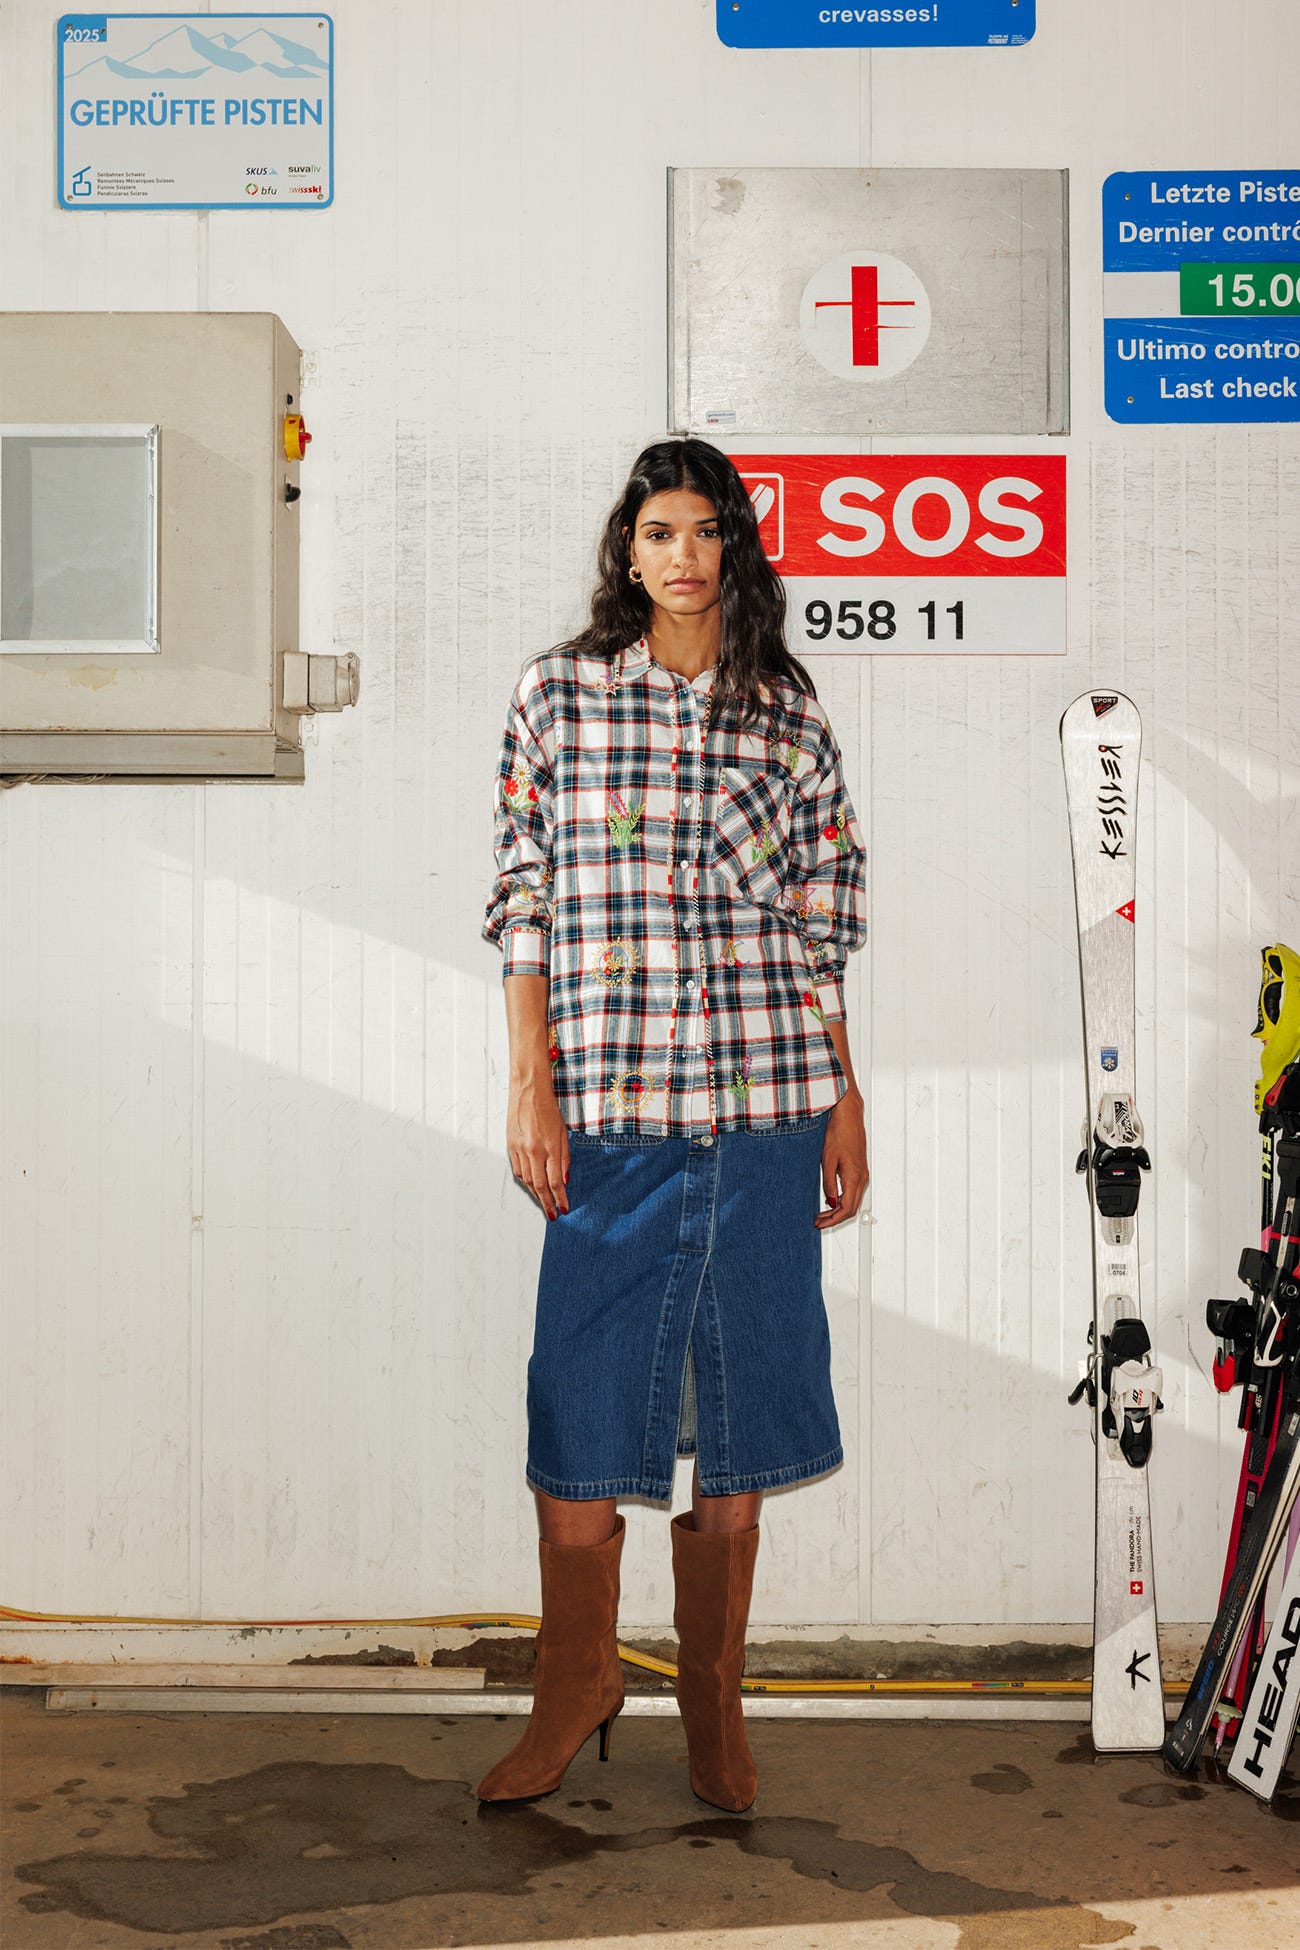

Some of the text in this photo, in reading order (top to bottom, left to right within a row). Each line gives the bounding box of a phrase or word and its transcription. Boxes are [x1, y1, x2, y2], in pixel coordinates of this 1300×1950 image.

[818, 4, 938, 23] crevasses!
[65, 28, 100, 42] 2025
[70, 92, 321, 126] GEPRÜFTE PISTEN
[245, 167, 268, 176] SKUS
[261, 186, 278, 196] bfu
[1151, 180, 1300, 204] Letzte Piste
[1119, 220, 1215, 243] Dernier
[1208, 273, 1300, 307] 15.0
[1117, 339, 1300, 361] Ultimo contro
[1160, 376, 1298, 399] Last check
[815, 476, 1044, 558] SOS
[804, 600, 964, 641] 958 11
[1097, 744, 1128, 860] KESSLER
[1261, 1135, 1271, 1180] EKI
[1217, 1617, 1234, 1657] COURSE
[1244, 1596, 1300, 1779] HEAD
